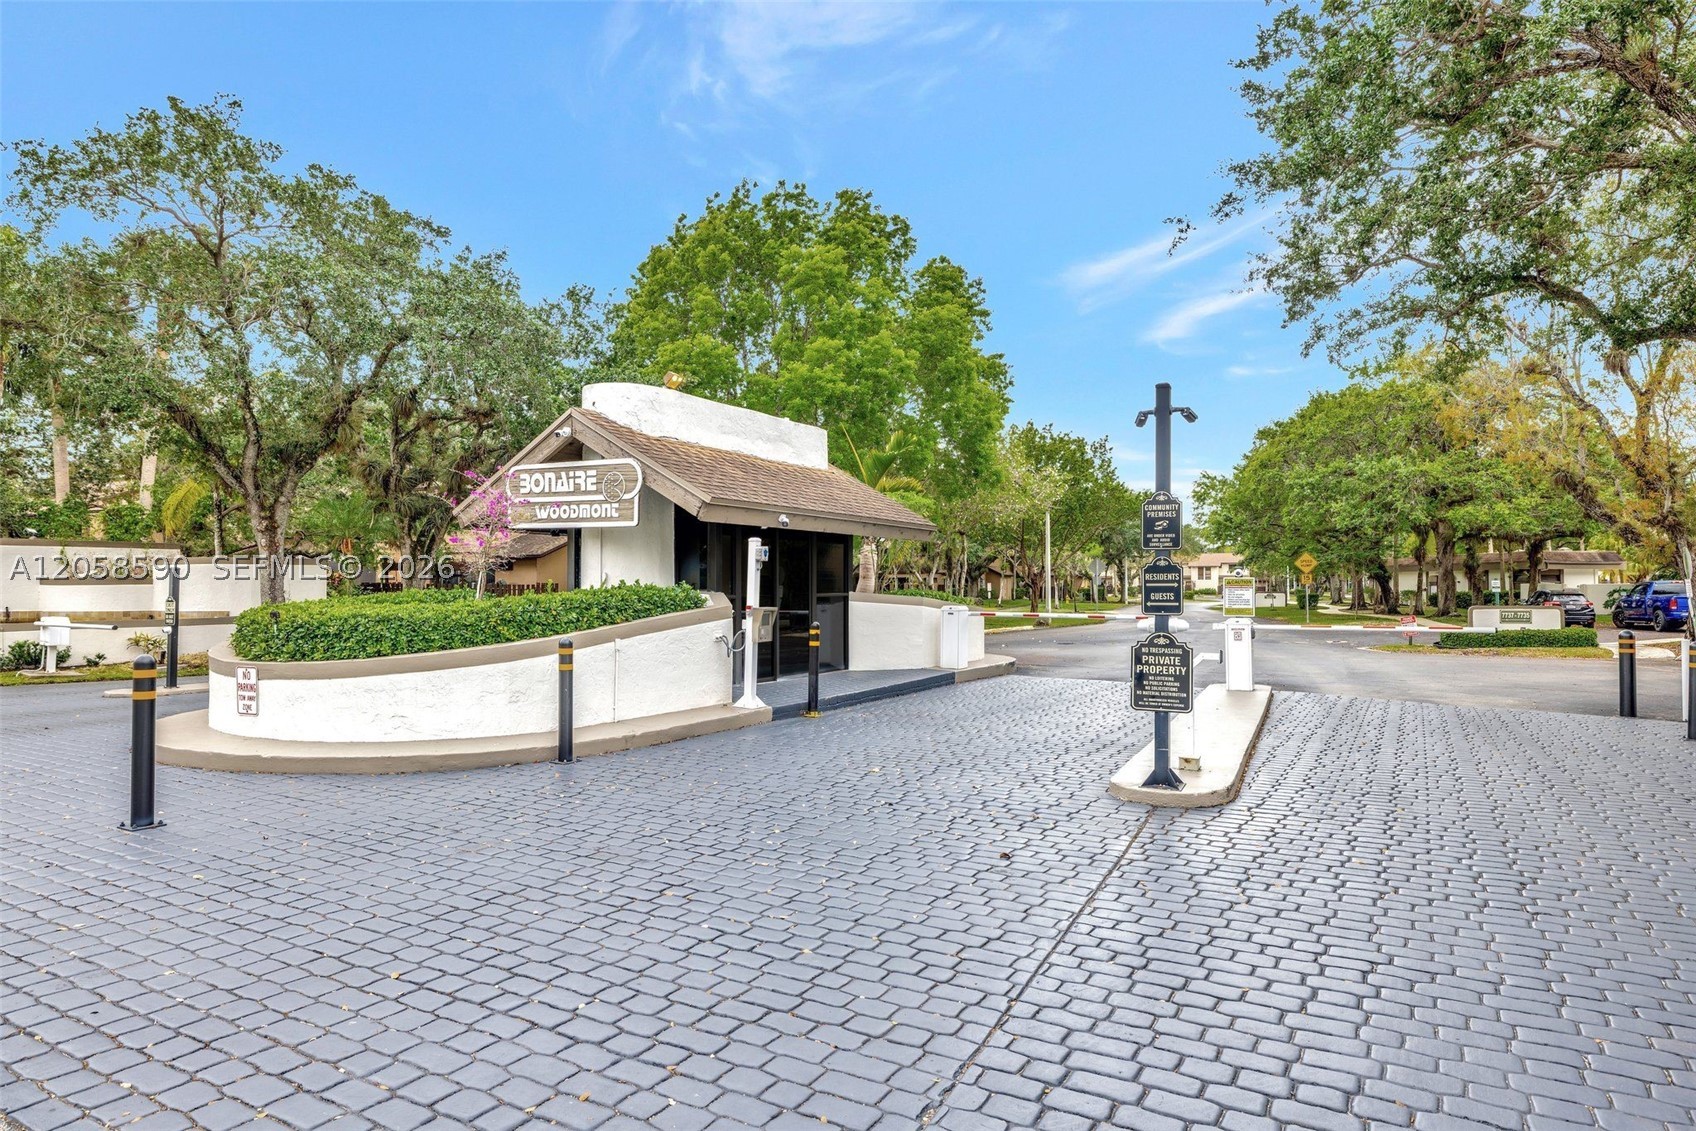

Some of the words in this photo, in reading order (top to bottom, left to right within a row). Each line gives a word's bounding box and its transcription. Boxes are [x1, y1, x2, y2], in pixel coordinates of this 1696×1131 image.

[1145, 573, 1180, 581] RESIDENTS
[1142, 656, 1180, 665] PRIVATE
[1136, 664, 1186, 675] PROPERTY
[242, 670, 251, 680] NO
[238, 682, 256, 692] PARKING
[242, 704, 252, 712] ZONE
